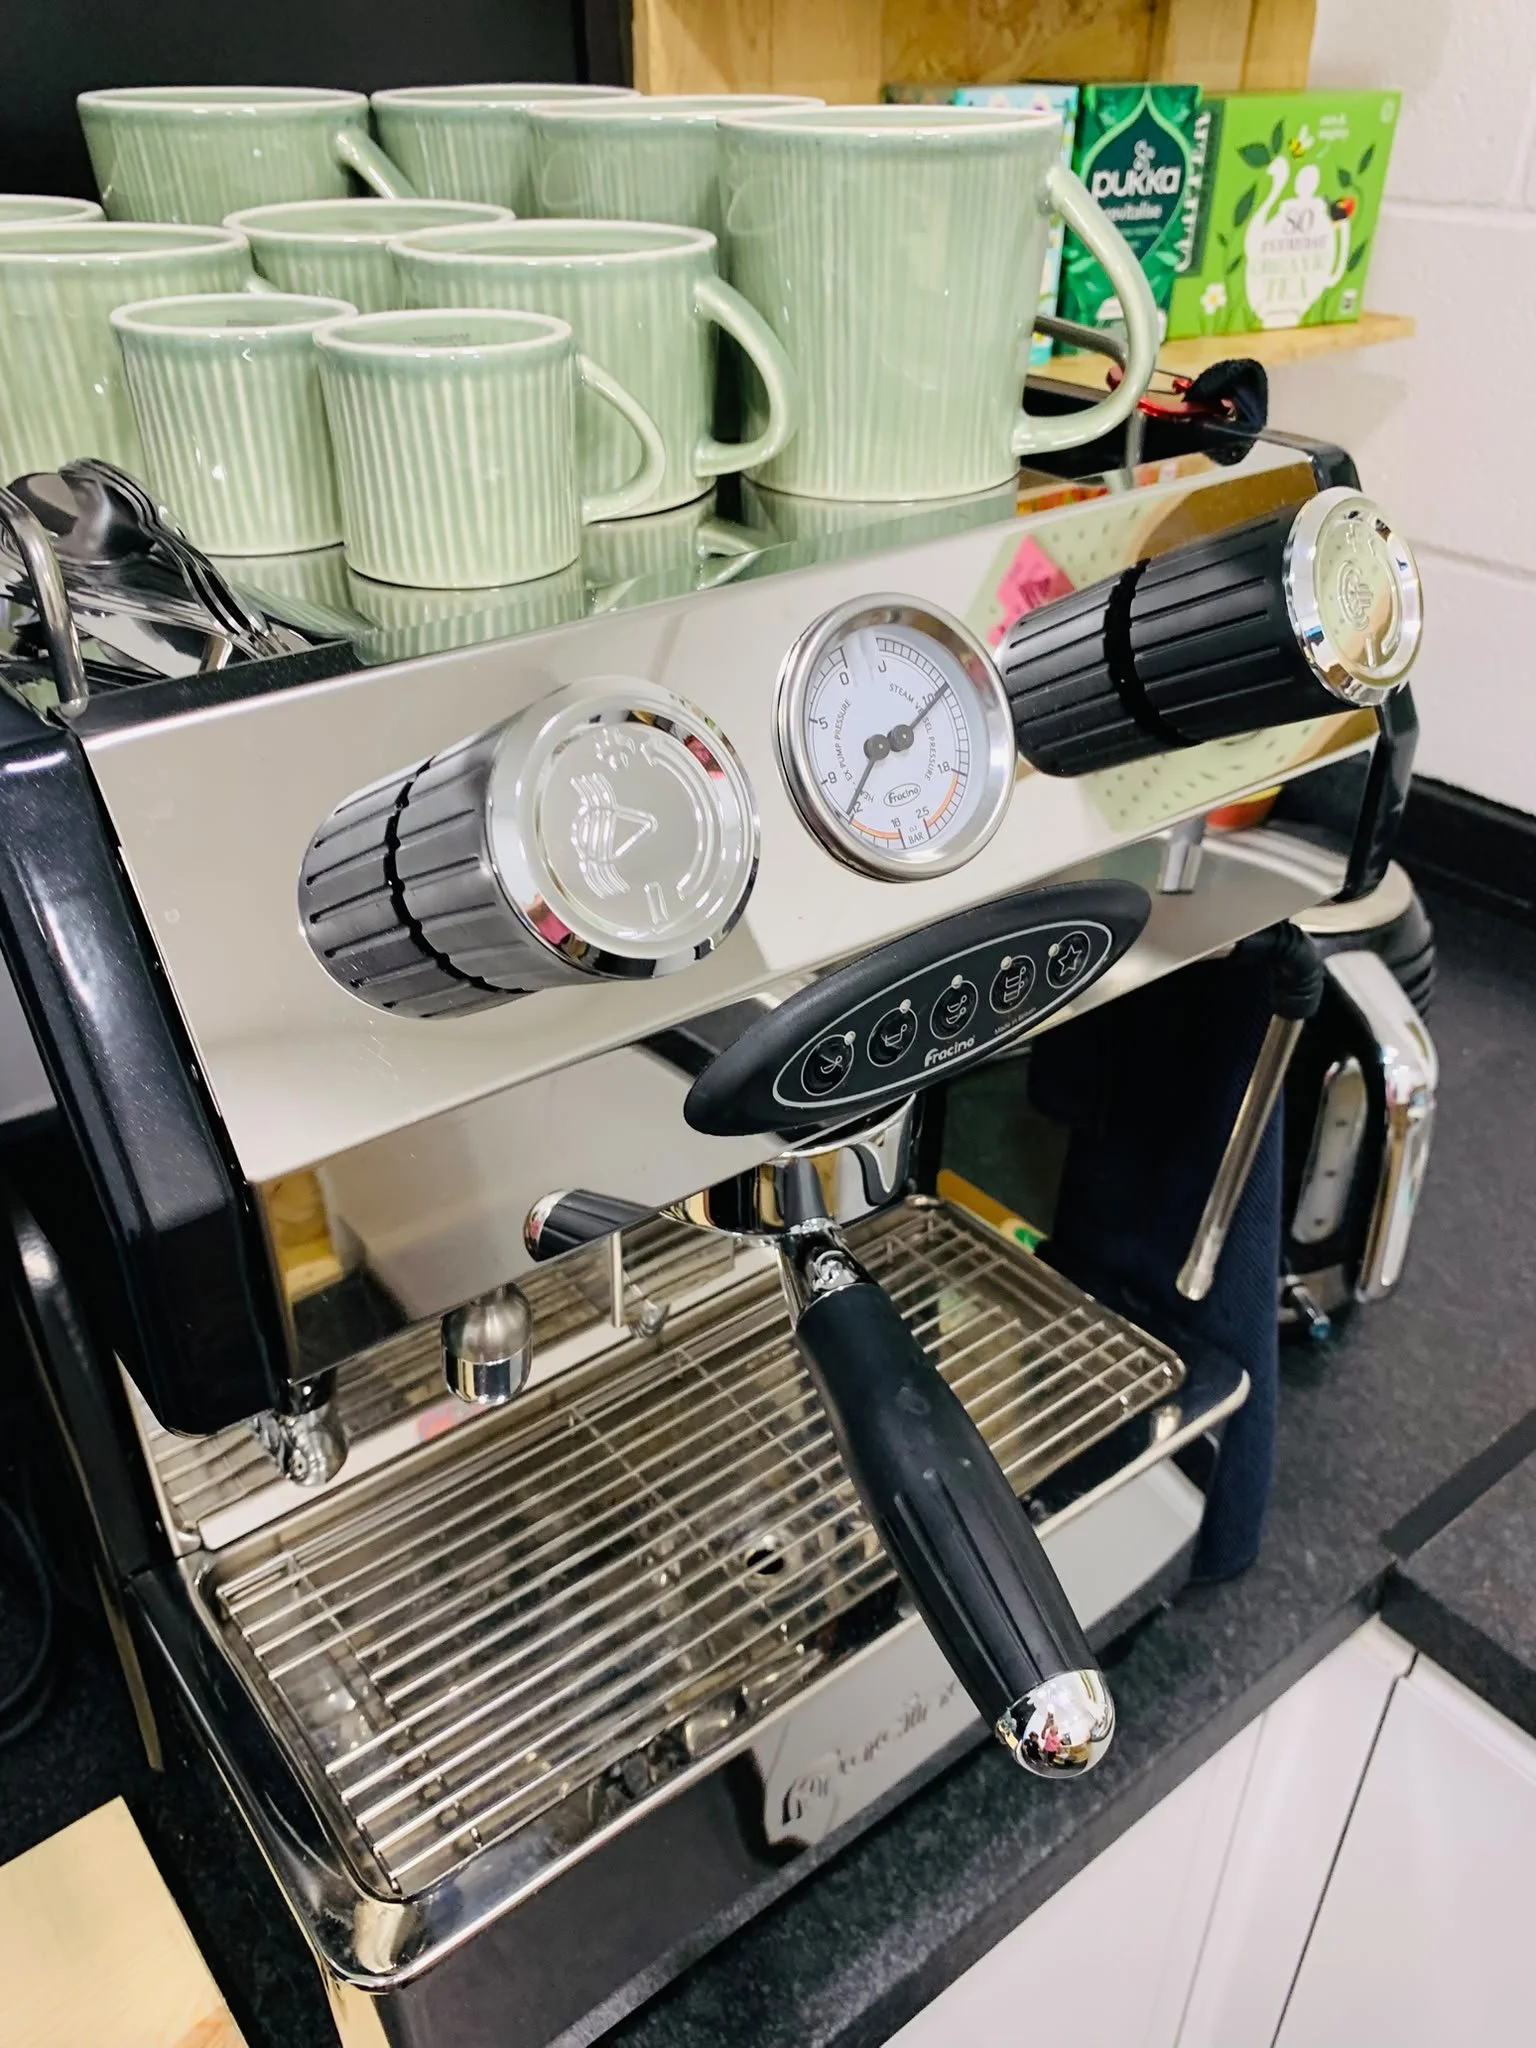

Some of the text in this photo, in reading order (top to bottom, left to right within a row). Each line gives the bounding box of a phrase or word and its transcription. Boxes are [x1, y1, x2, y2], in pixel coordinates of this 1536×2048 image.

[1092, 166, 1182, 199] pukka
[1281, 207, 1316, 236] SO
[839, 671, 850, 686] 0
[817, 716, 829, 730] 5
[834, 699, 851, 741] PRESSURE
[889, 682, 937, 782] STEAM VESEL PRESSURE
[834, 742, 846, 768] PUMP
[908, 832, 925, 845] BAR
